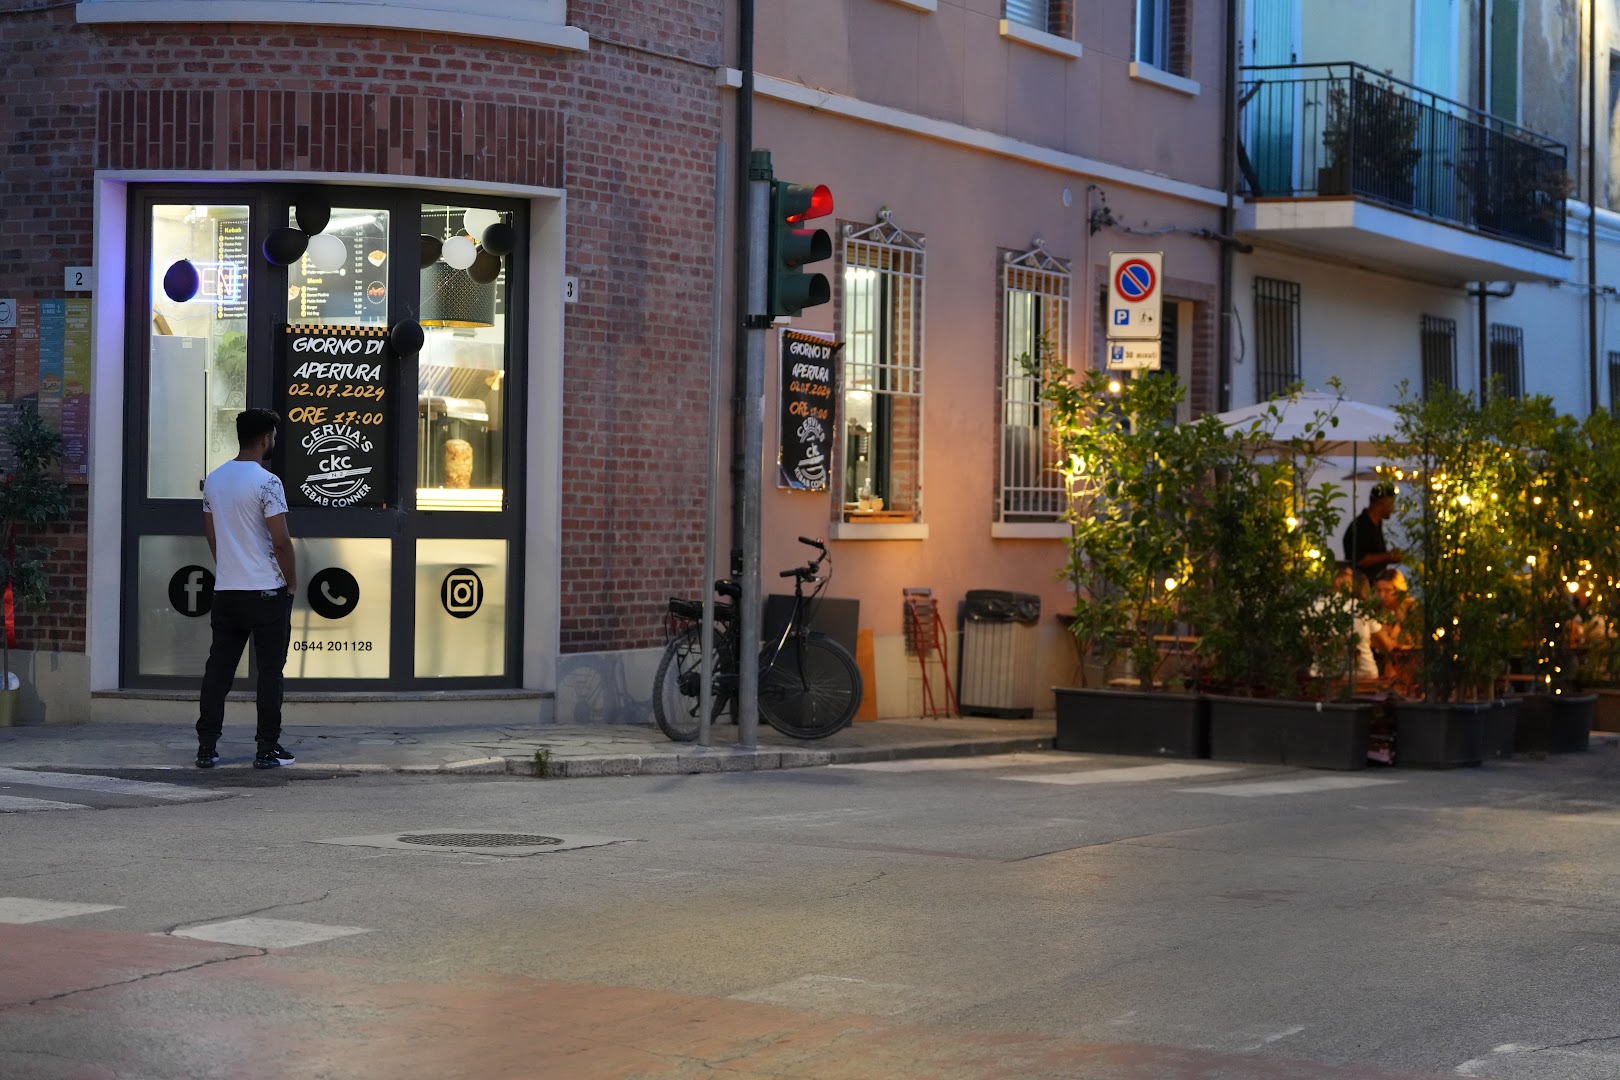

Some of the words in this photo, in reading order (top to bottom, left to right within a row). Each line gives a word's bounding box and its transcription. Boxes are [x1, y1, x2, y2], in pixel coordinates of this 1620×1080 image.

[76, 272, 82, 286] 2
[567, 282, 572, 297] 3
[292, 337, 362, 355] GIORNO
[365, 340, 385, 355] DI
[790, 342, 820, 358] GIORNO
[822, 347, 831, 359] DI
[293, 362, 381, 381] APERTURA
[792, 363, 829, 382] APERTURA
[288, 383, 385, 402] 02.07.2024
[288, 406, 328, 424] ORE
[332, 411, 383, 425] 17:00
[789, 401, 809, 417] ORE
[301, 424, 373, 452] CERVIA'S
[300, 482, 329, 506] KEBAB
[332, 484, 371, 508] CONNER
[293, 642, 323, 651] 0544
[327, 642, 372, 651] 201128
